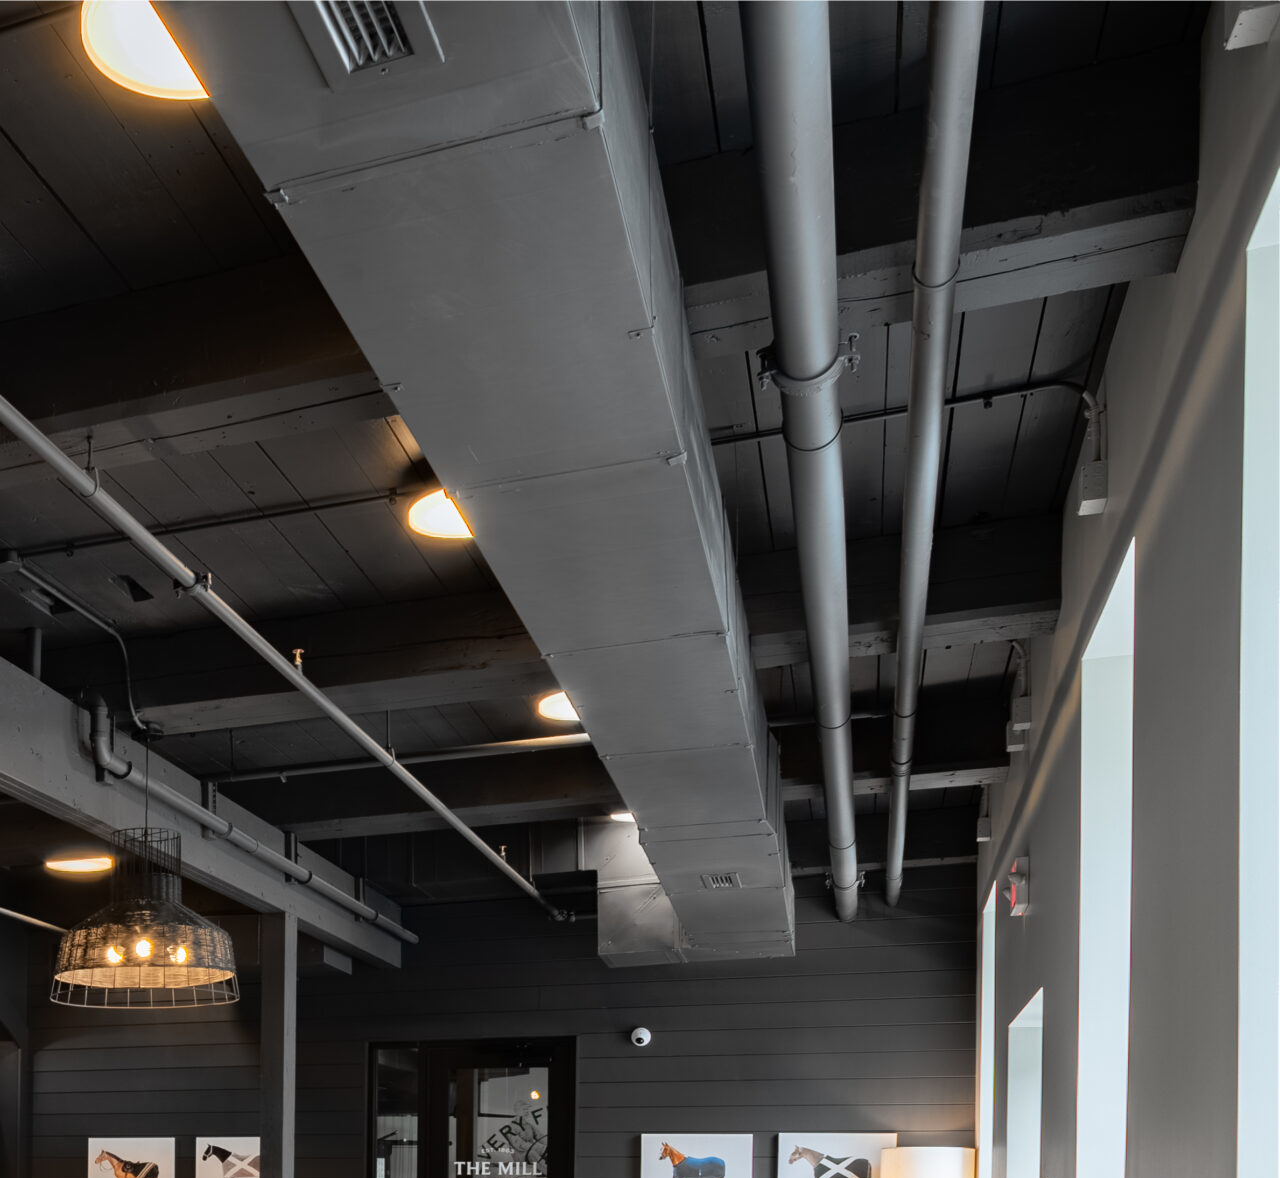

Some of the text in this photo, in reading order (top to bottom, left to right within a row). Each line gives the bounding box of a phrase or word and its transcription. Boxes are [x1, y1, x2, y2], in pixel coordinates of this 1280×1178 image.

[477, 1107, 548, 1160] VERY F
[453, 1161, 542, 1176] THE MILL
